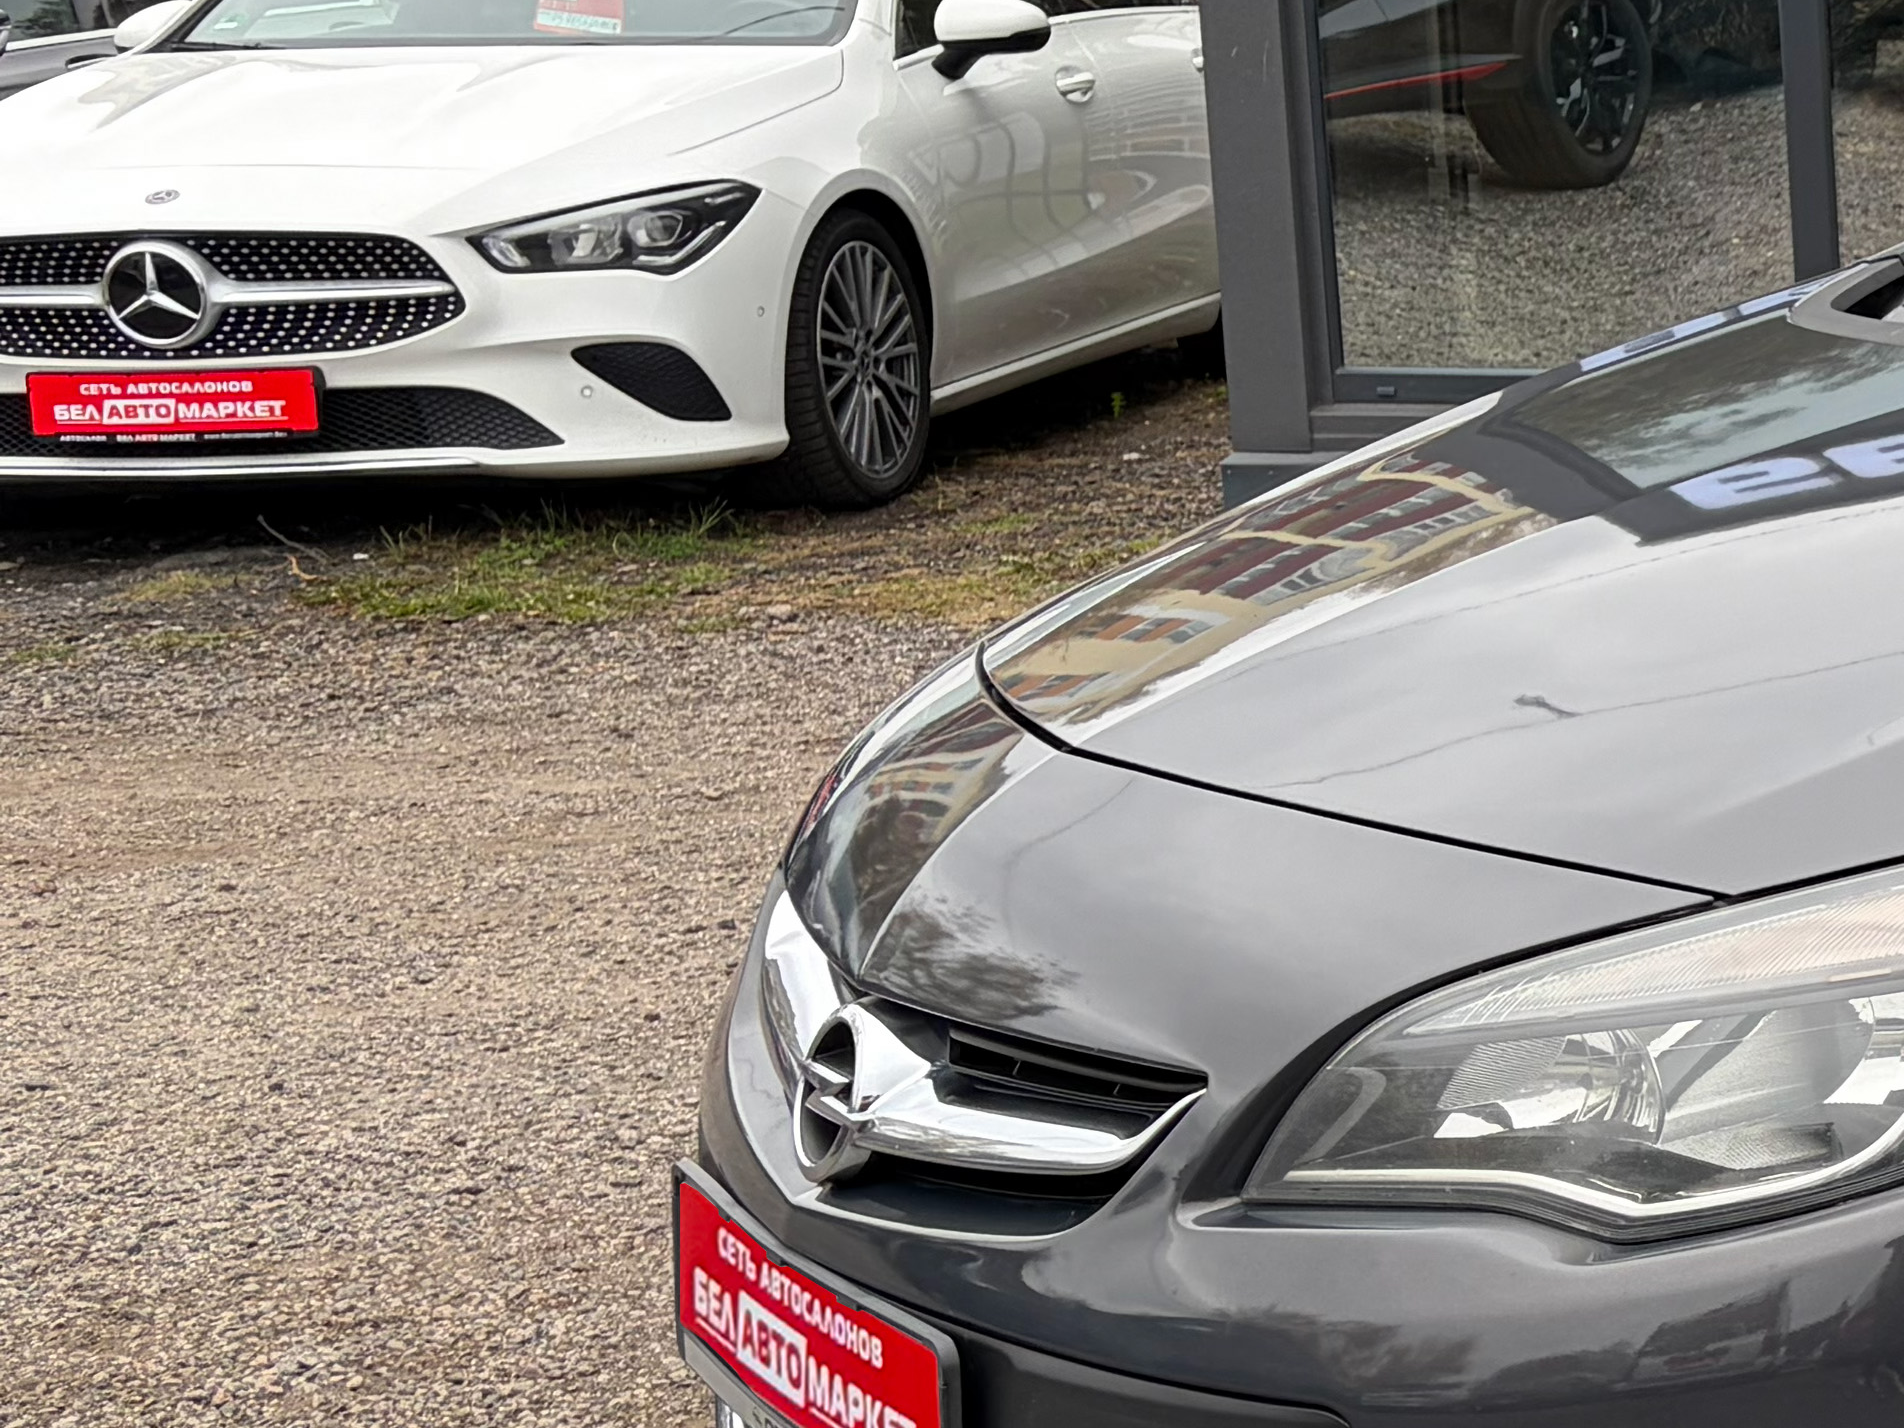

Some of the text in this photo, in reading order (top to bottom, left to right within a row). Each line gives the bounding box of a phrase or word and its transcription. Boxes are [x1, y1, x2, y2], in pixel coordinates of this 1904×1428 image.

[53, 400, 286, 422] БЕЛ АВТО МАРКЕТ
[79, 380, 253, 395] СЕТЬ АВТОСАЛОНОВ
[693, 1266, 736, 1343] БЕЛ
[740, 1306, 802, 1392] АВТО
[717, 1227, 884, 1370] СЕТЬ АВТОСАЛОНОВ
